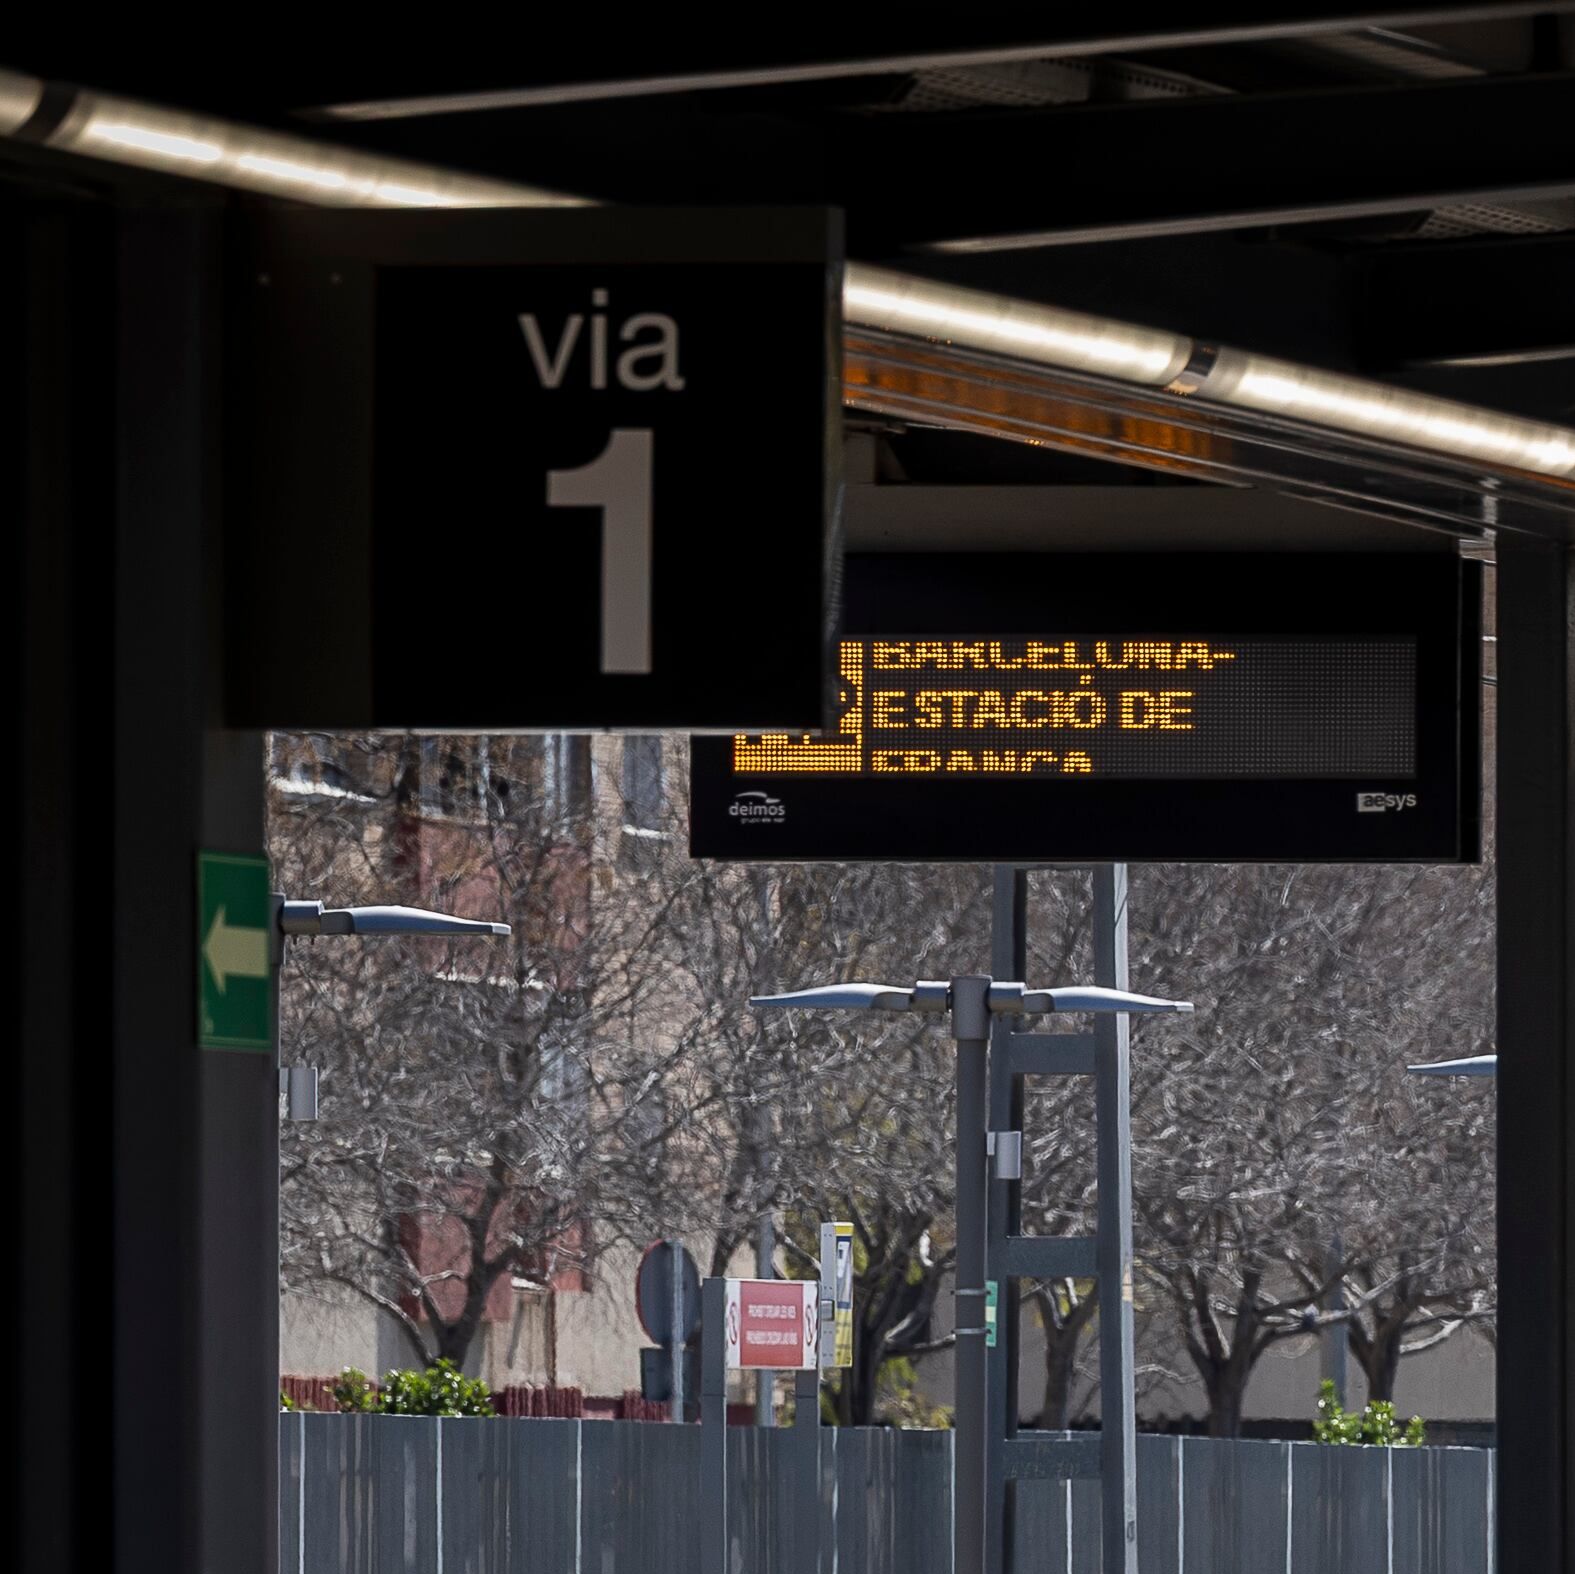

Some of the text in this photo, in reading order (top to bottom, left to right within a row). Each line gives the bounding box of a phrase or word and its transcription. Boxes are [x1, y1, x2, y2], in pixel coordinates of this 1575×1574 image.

[518, 288, 686, 391] via
[546, 427, 654, 673] 1
[873, 674, 1106, 729] ESTACIÓ
[1121, 691, 1197, 729] DE
[728, 802, 785, 816] deimos
[1361, 793, 1416, 811] aesys
